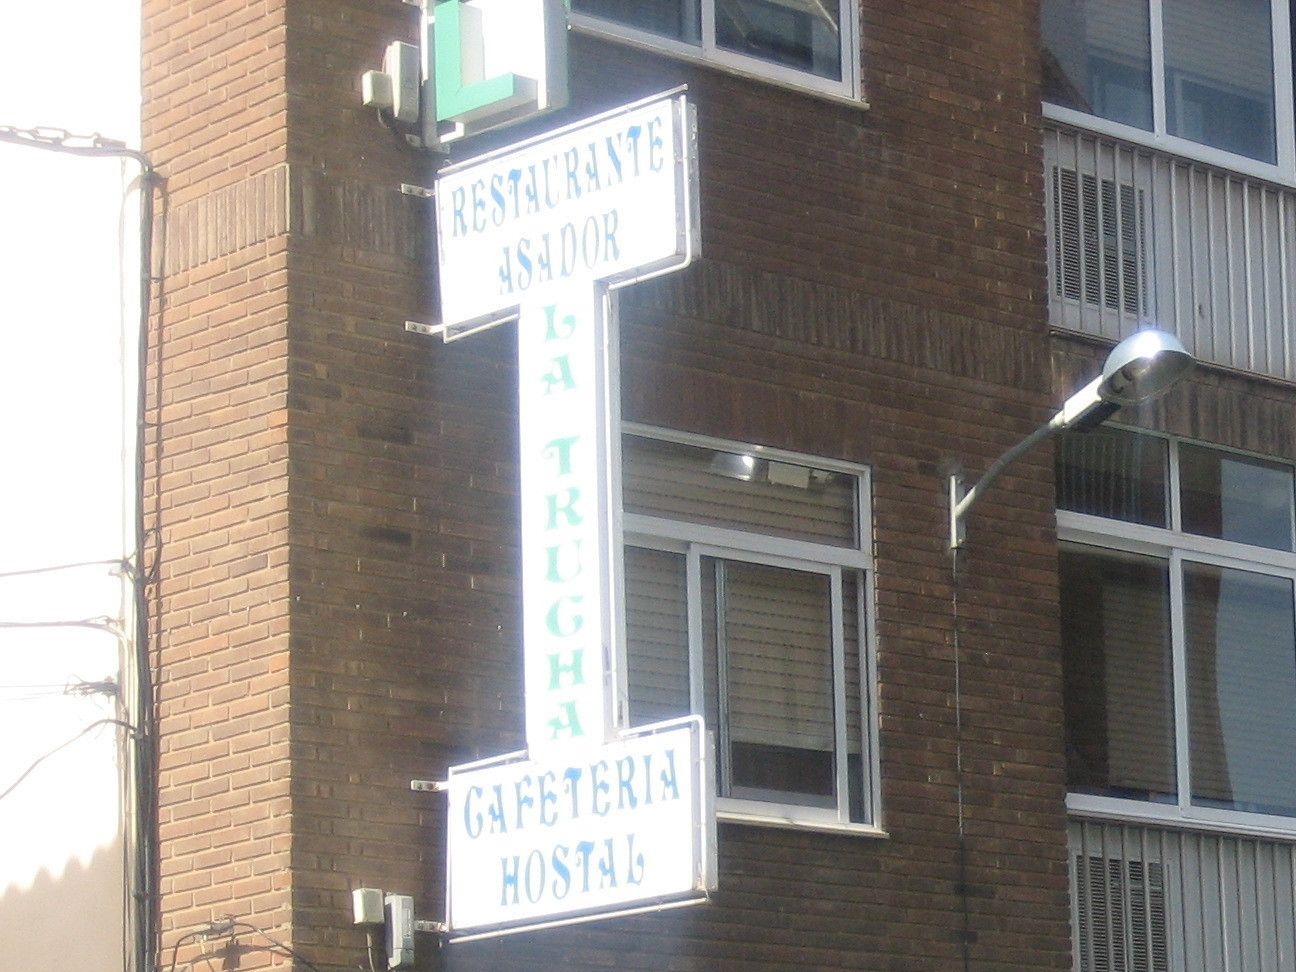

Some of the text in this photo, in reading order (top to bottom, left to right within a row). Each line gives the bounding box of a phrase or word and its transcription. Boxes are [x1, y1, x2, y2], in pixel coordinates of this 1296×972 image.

[451, 116, 664, 238] RESTAURANTE
[499, 208, 620, 296] ASADOR
[463, 749, 680, 840] CAFETERIA
[500, 833, 645, 908] HOSTAL
